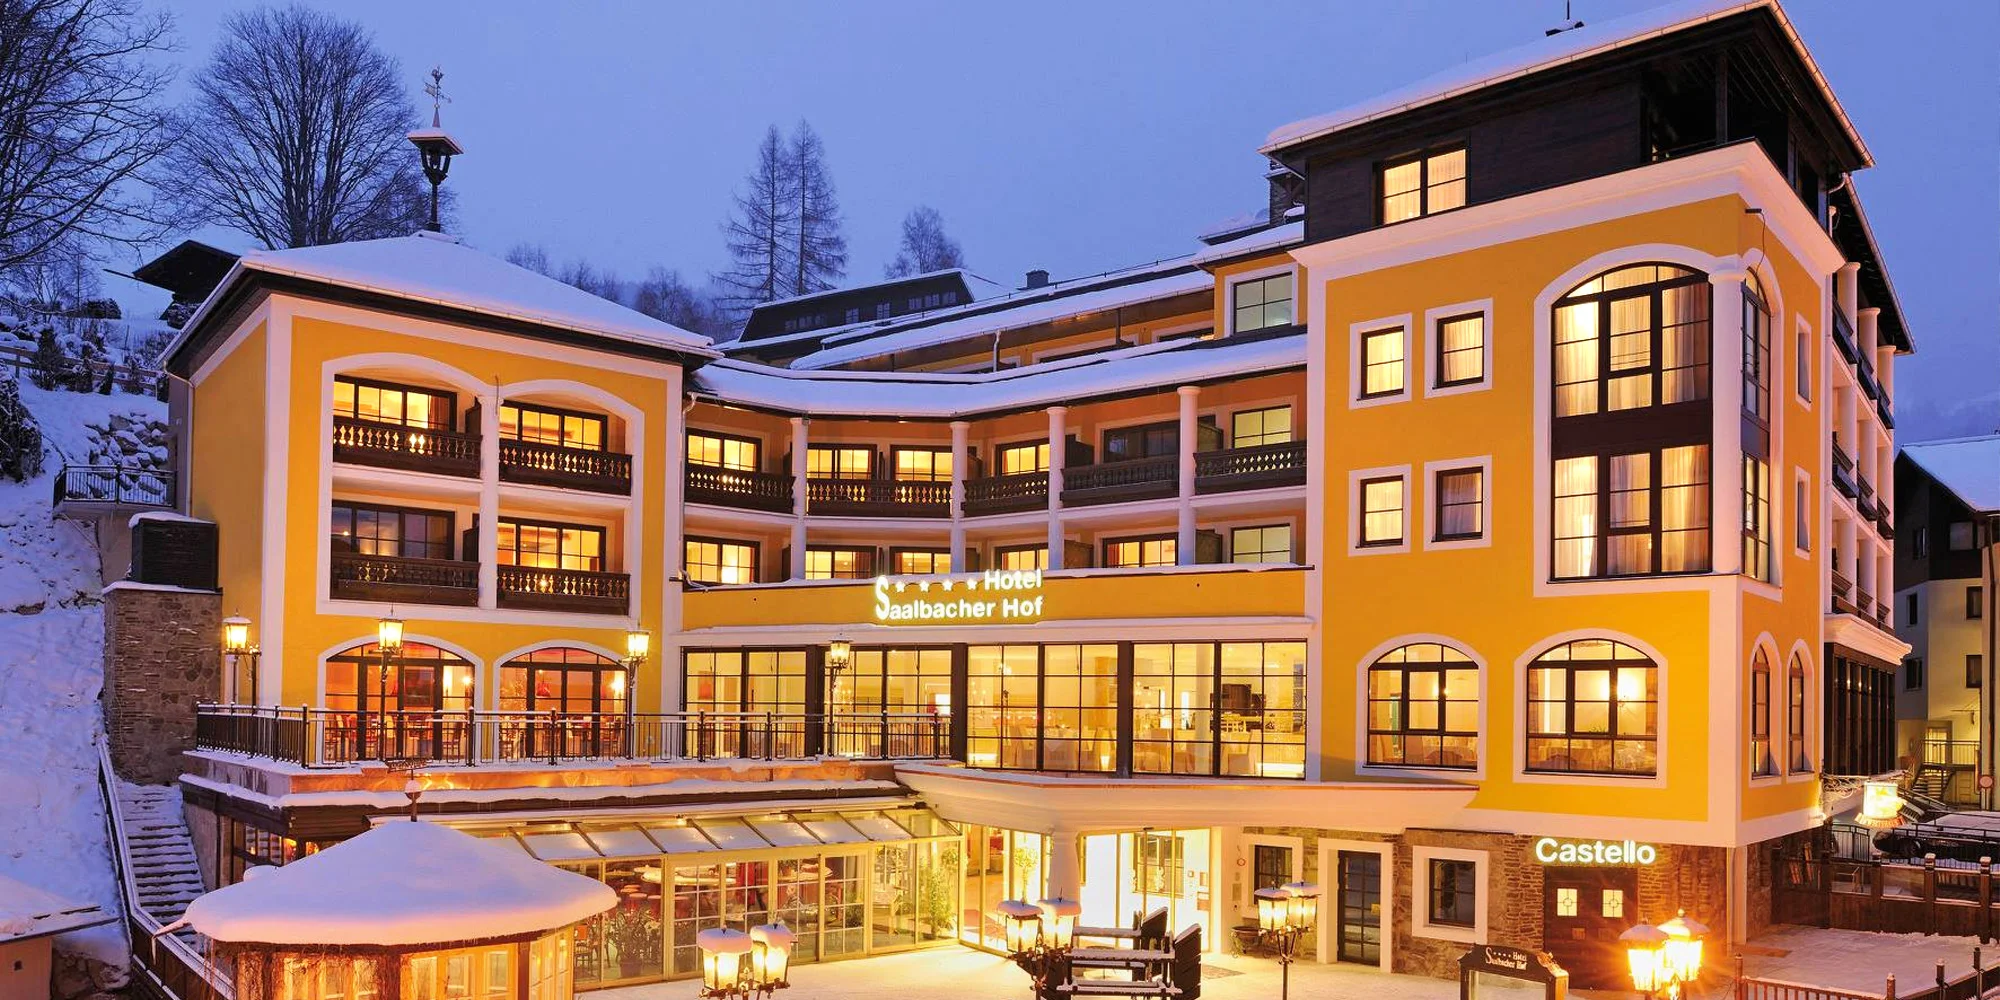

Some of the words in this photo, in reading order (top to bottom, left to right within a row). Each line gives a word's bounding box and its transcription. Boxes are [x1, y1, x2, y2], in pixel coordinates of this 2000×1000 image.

[984, 568, 1042, 590] Hotel
[875, 575, 996, 620] Saalbacher
[1003, 595, 1043, 618] Hof
[1535, 838, 1656, 864] Castello
